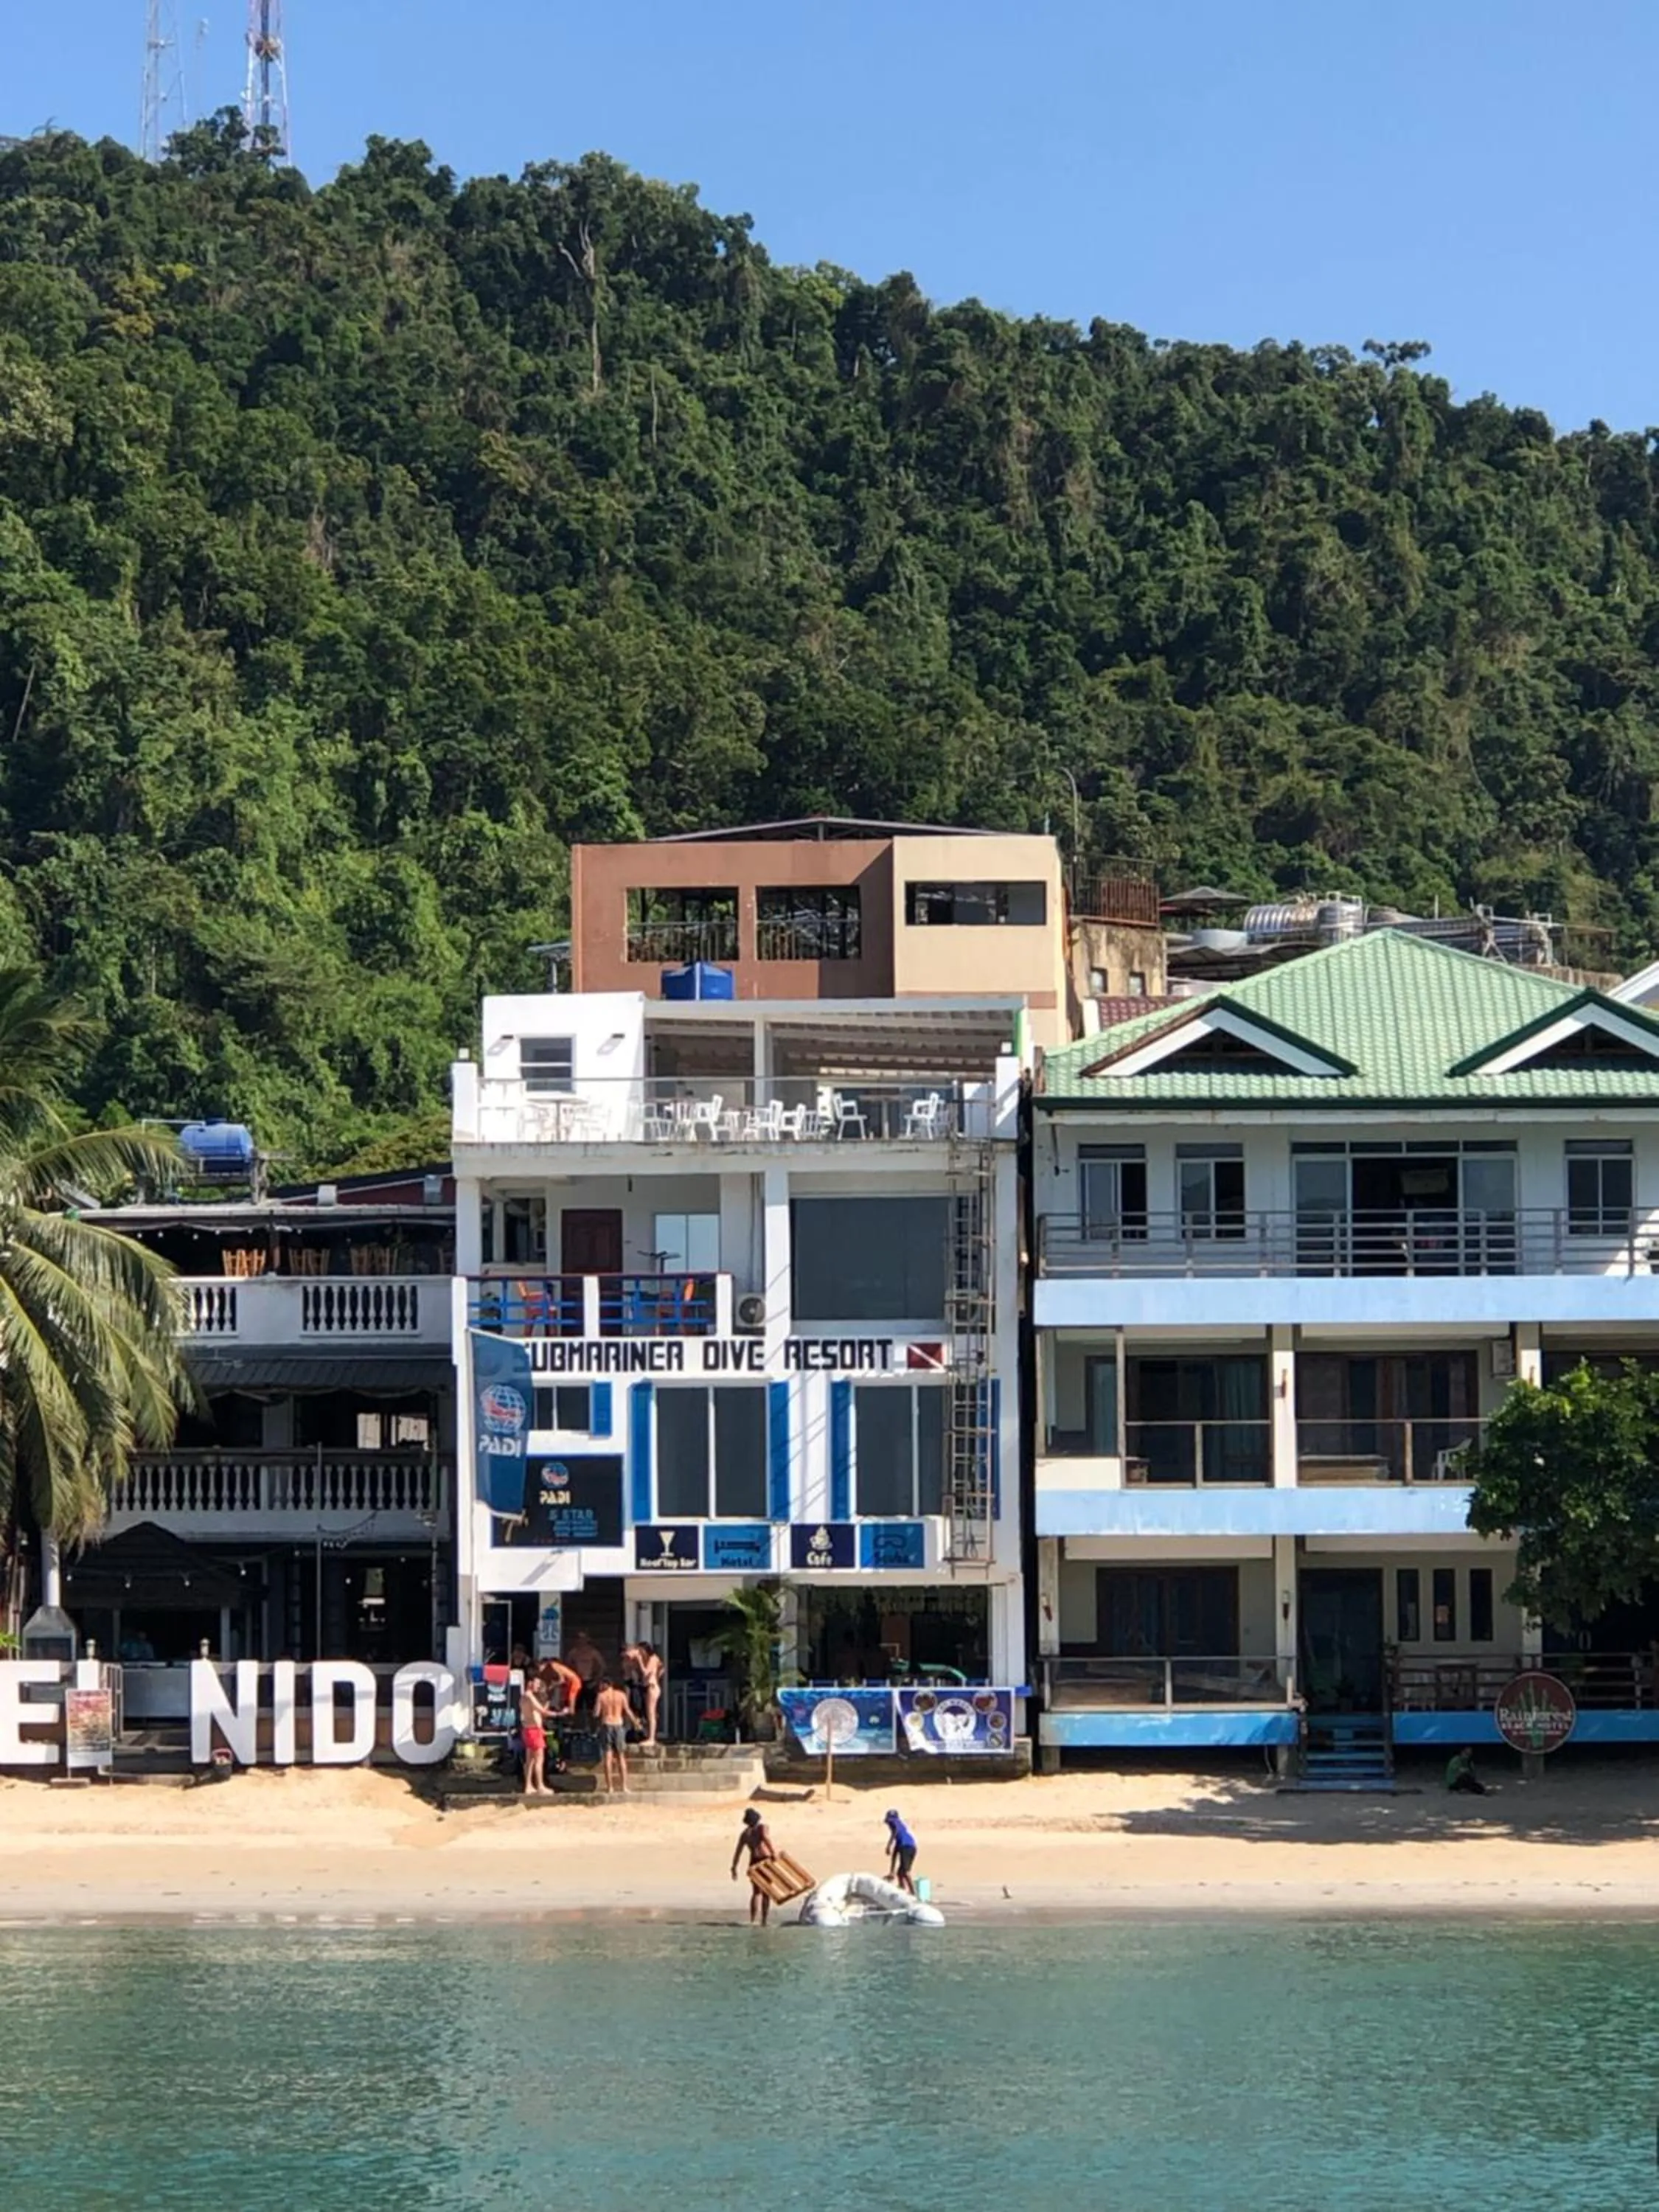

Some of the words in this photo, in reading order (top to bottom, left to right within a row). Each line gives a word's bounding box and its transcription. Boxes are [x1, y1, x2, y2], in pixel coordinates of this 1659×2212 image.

[525, 1340, 683, 1371] UBMARINER
[703, 1340, 764, 1371] DIVE
[783, 1339, 892, 1370] RESORT
[479, 1434, 521, 1458] PADI
[539, 1489, 571, 1504] PADI
[190, 1660, 454, 1764] NIDO
[1499, 1706, 1572, 1722] Rainforest
